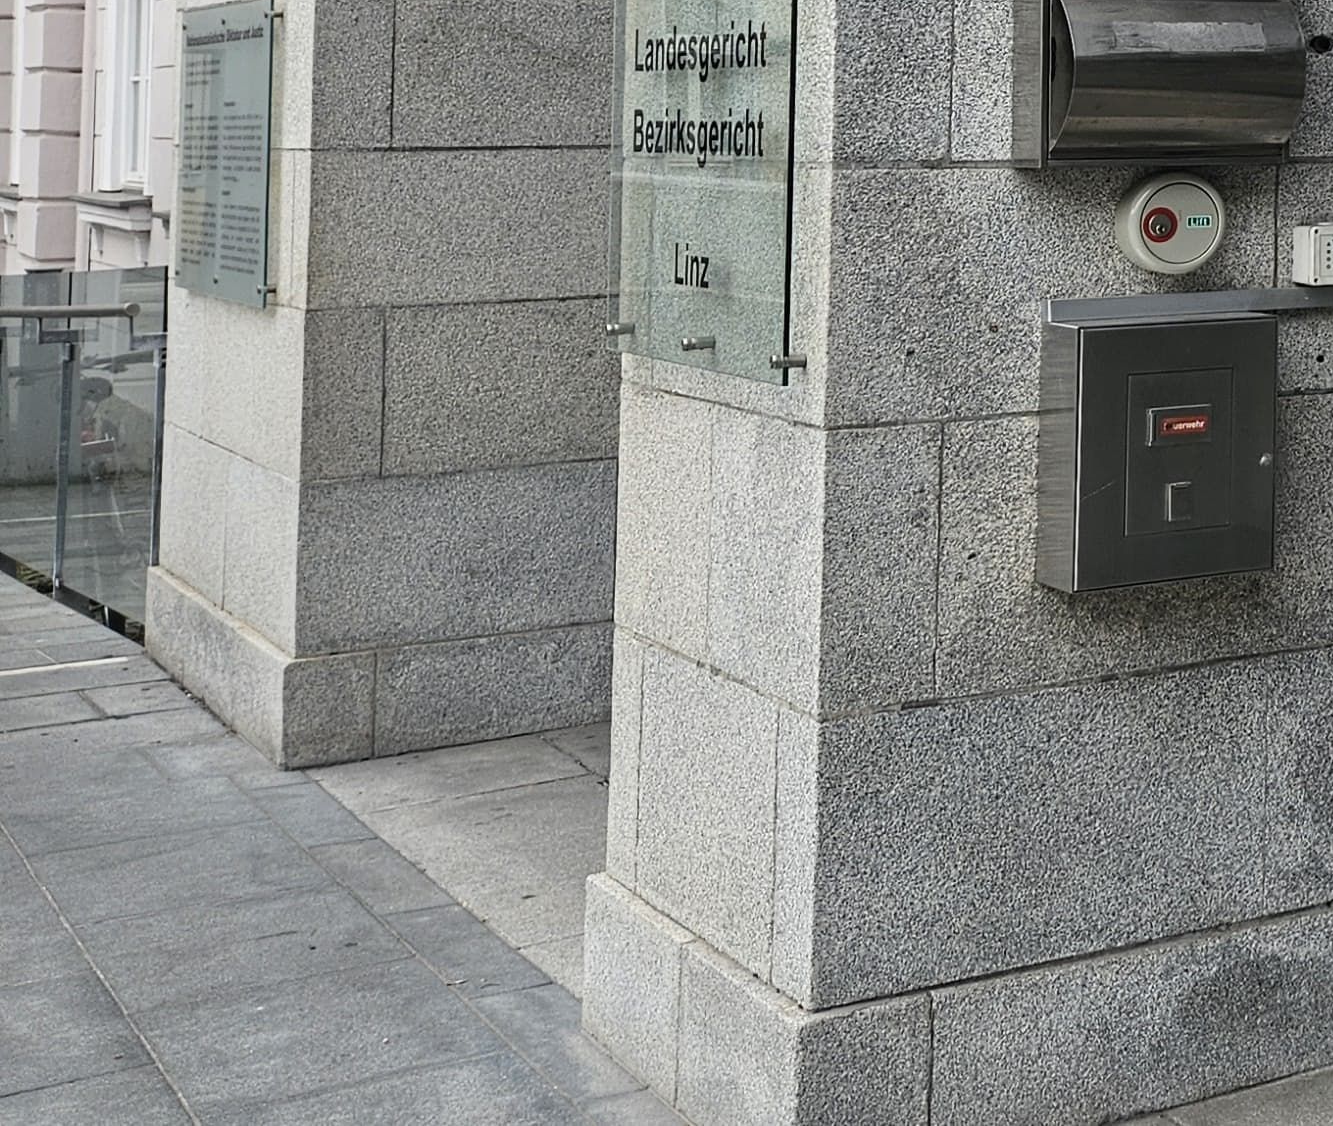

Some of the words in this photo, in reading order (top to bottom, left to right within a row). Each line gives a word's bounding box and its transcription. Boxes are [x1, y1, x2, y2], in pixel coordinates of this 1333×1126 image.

[634, 20, 767, 83] Landesgericht
[632, 108, 764, 168] Bezirksgericht
[673, 242, 710, 289] Linz
